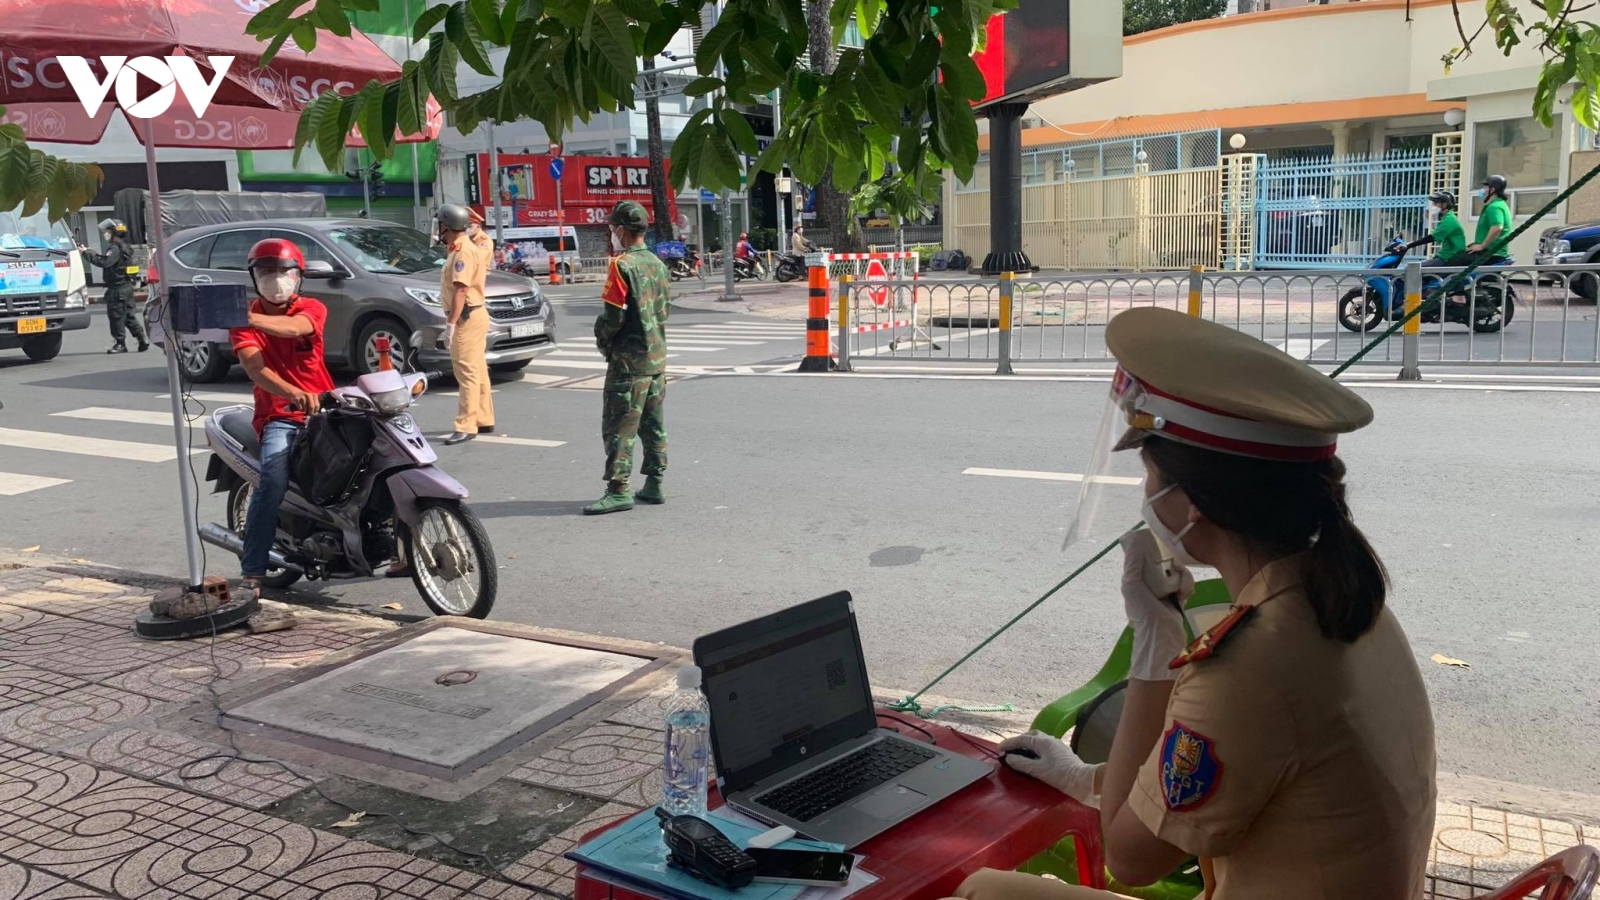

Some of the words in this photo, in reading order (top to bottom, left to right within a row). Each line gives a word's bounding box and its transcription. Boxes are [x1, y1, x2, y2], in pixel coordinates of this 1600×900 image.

[589, 166, 648, 186] SP1RT
[549, 209, 565, 217] SAE
[1163, 761, 1205, 791] CSGT
